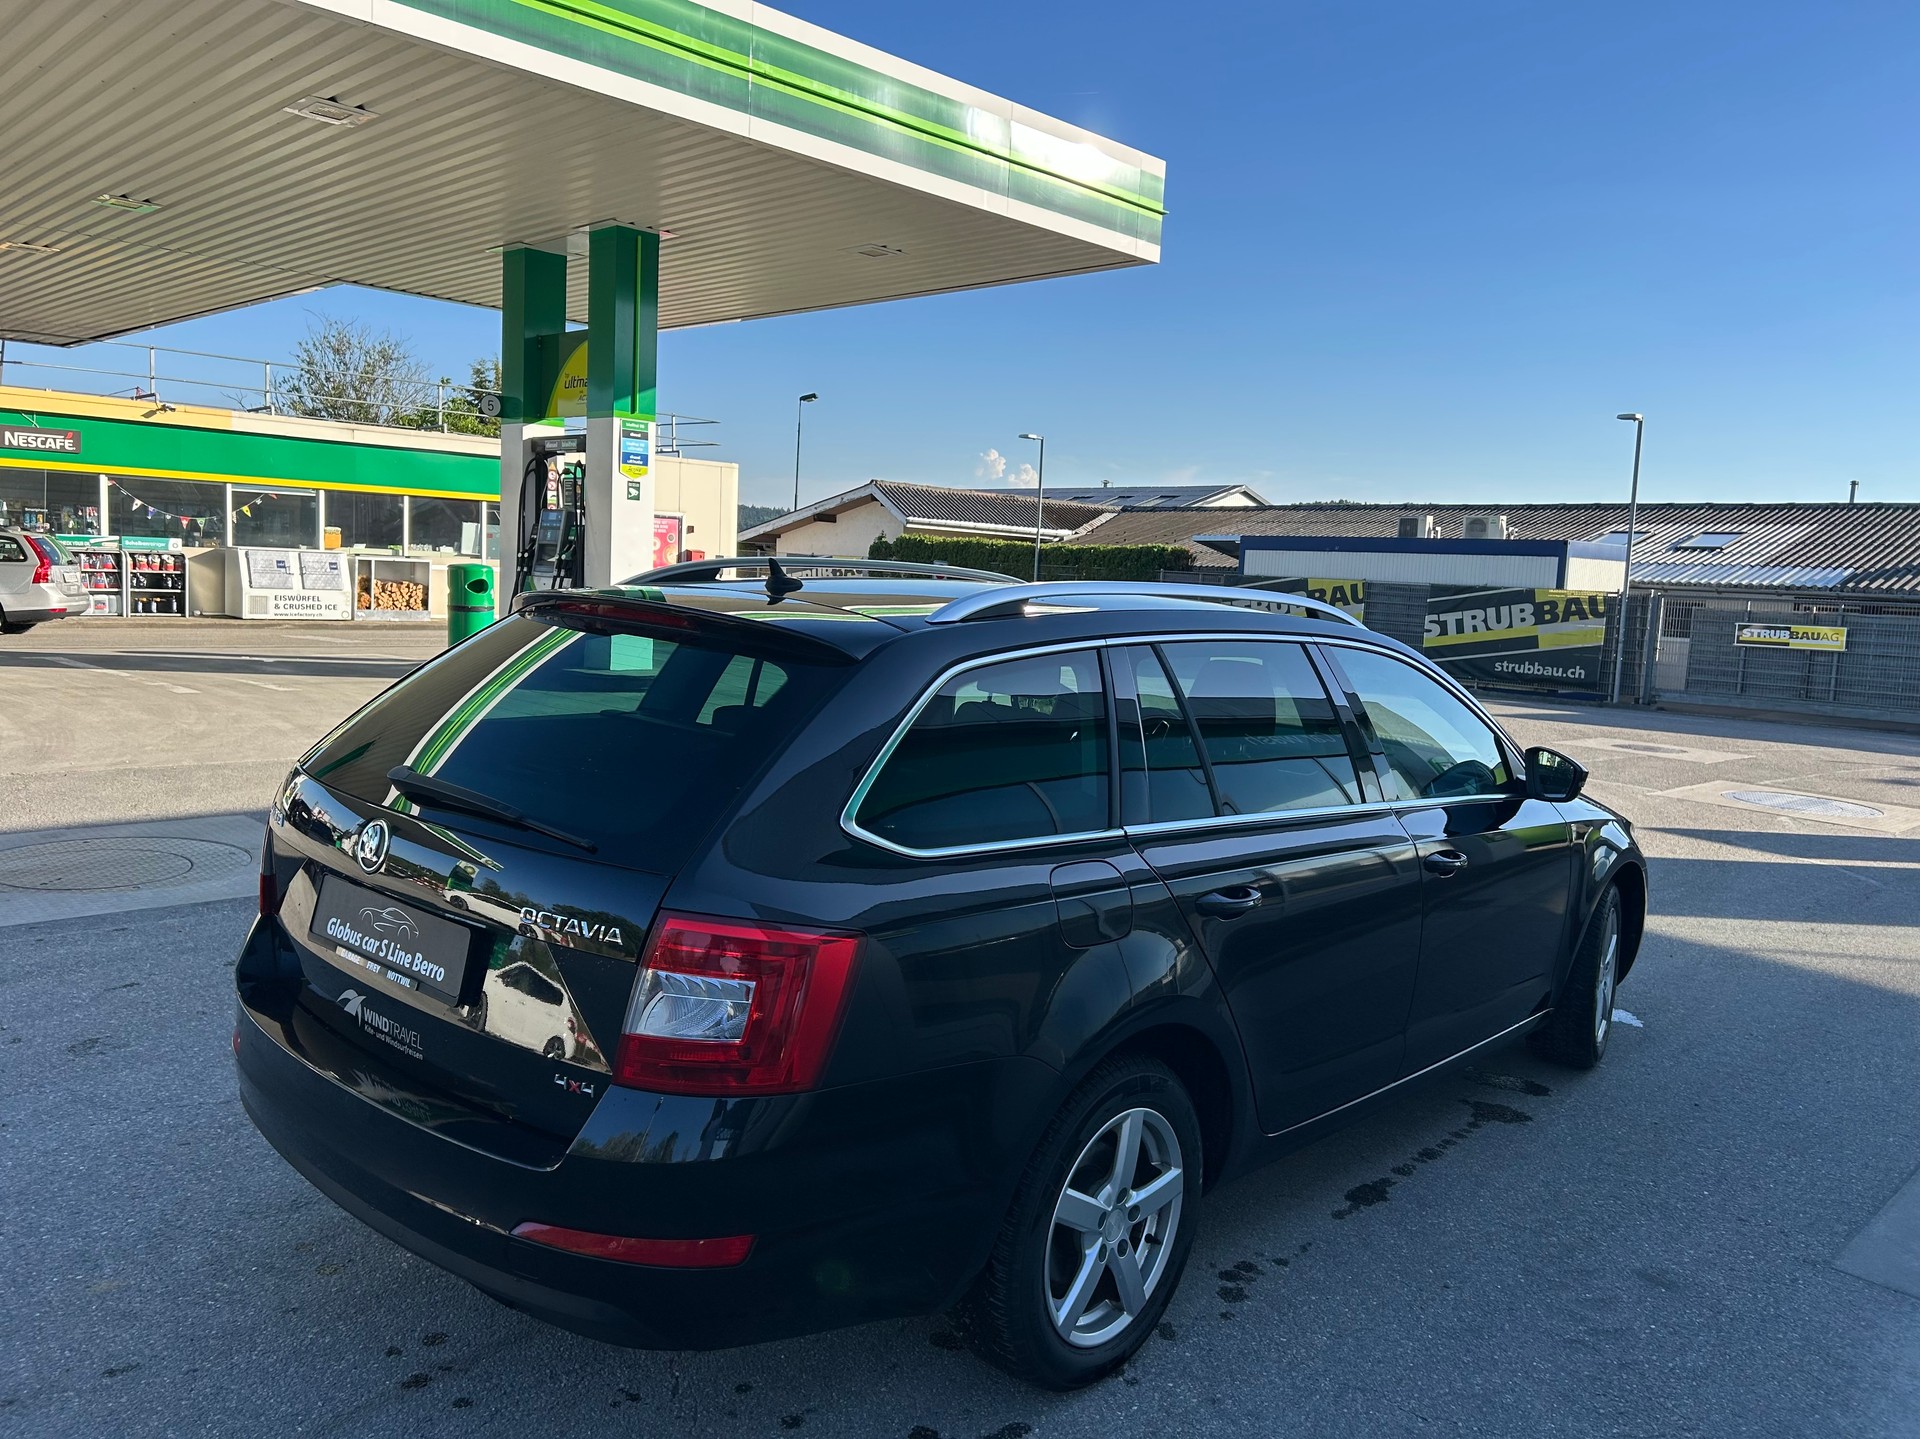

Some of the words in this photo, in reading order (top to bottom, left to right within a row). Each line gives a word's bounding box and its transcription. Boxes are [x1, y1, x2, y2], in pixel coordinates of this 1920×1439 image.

[487, 400, 495, 411] 5
[274, 594, 321, 602] EISWÜRFEL
[1423, 594, 1606, 638] STRUBBAU
[1494, 660, 1586, 679] strubbau.ch
[520, 907, 623, 946] OCTAVIA
[326, 917, 362, 947] Globus
[362, 936, 381, 954] car
[379, 939, 389, 957] S
[387, 942, 412, 969] Line
[411, 952, 445, 982] Berro
[366, 961, 382, 974] FREY
[386, 969, 411, 988] NOTTWIL
[363, 1006, 424, 1051] WINDTRAVEL
